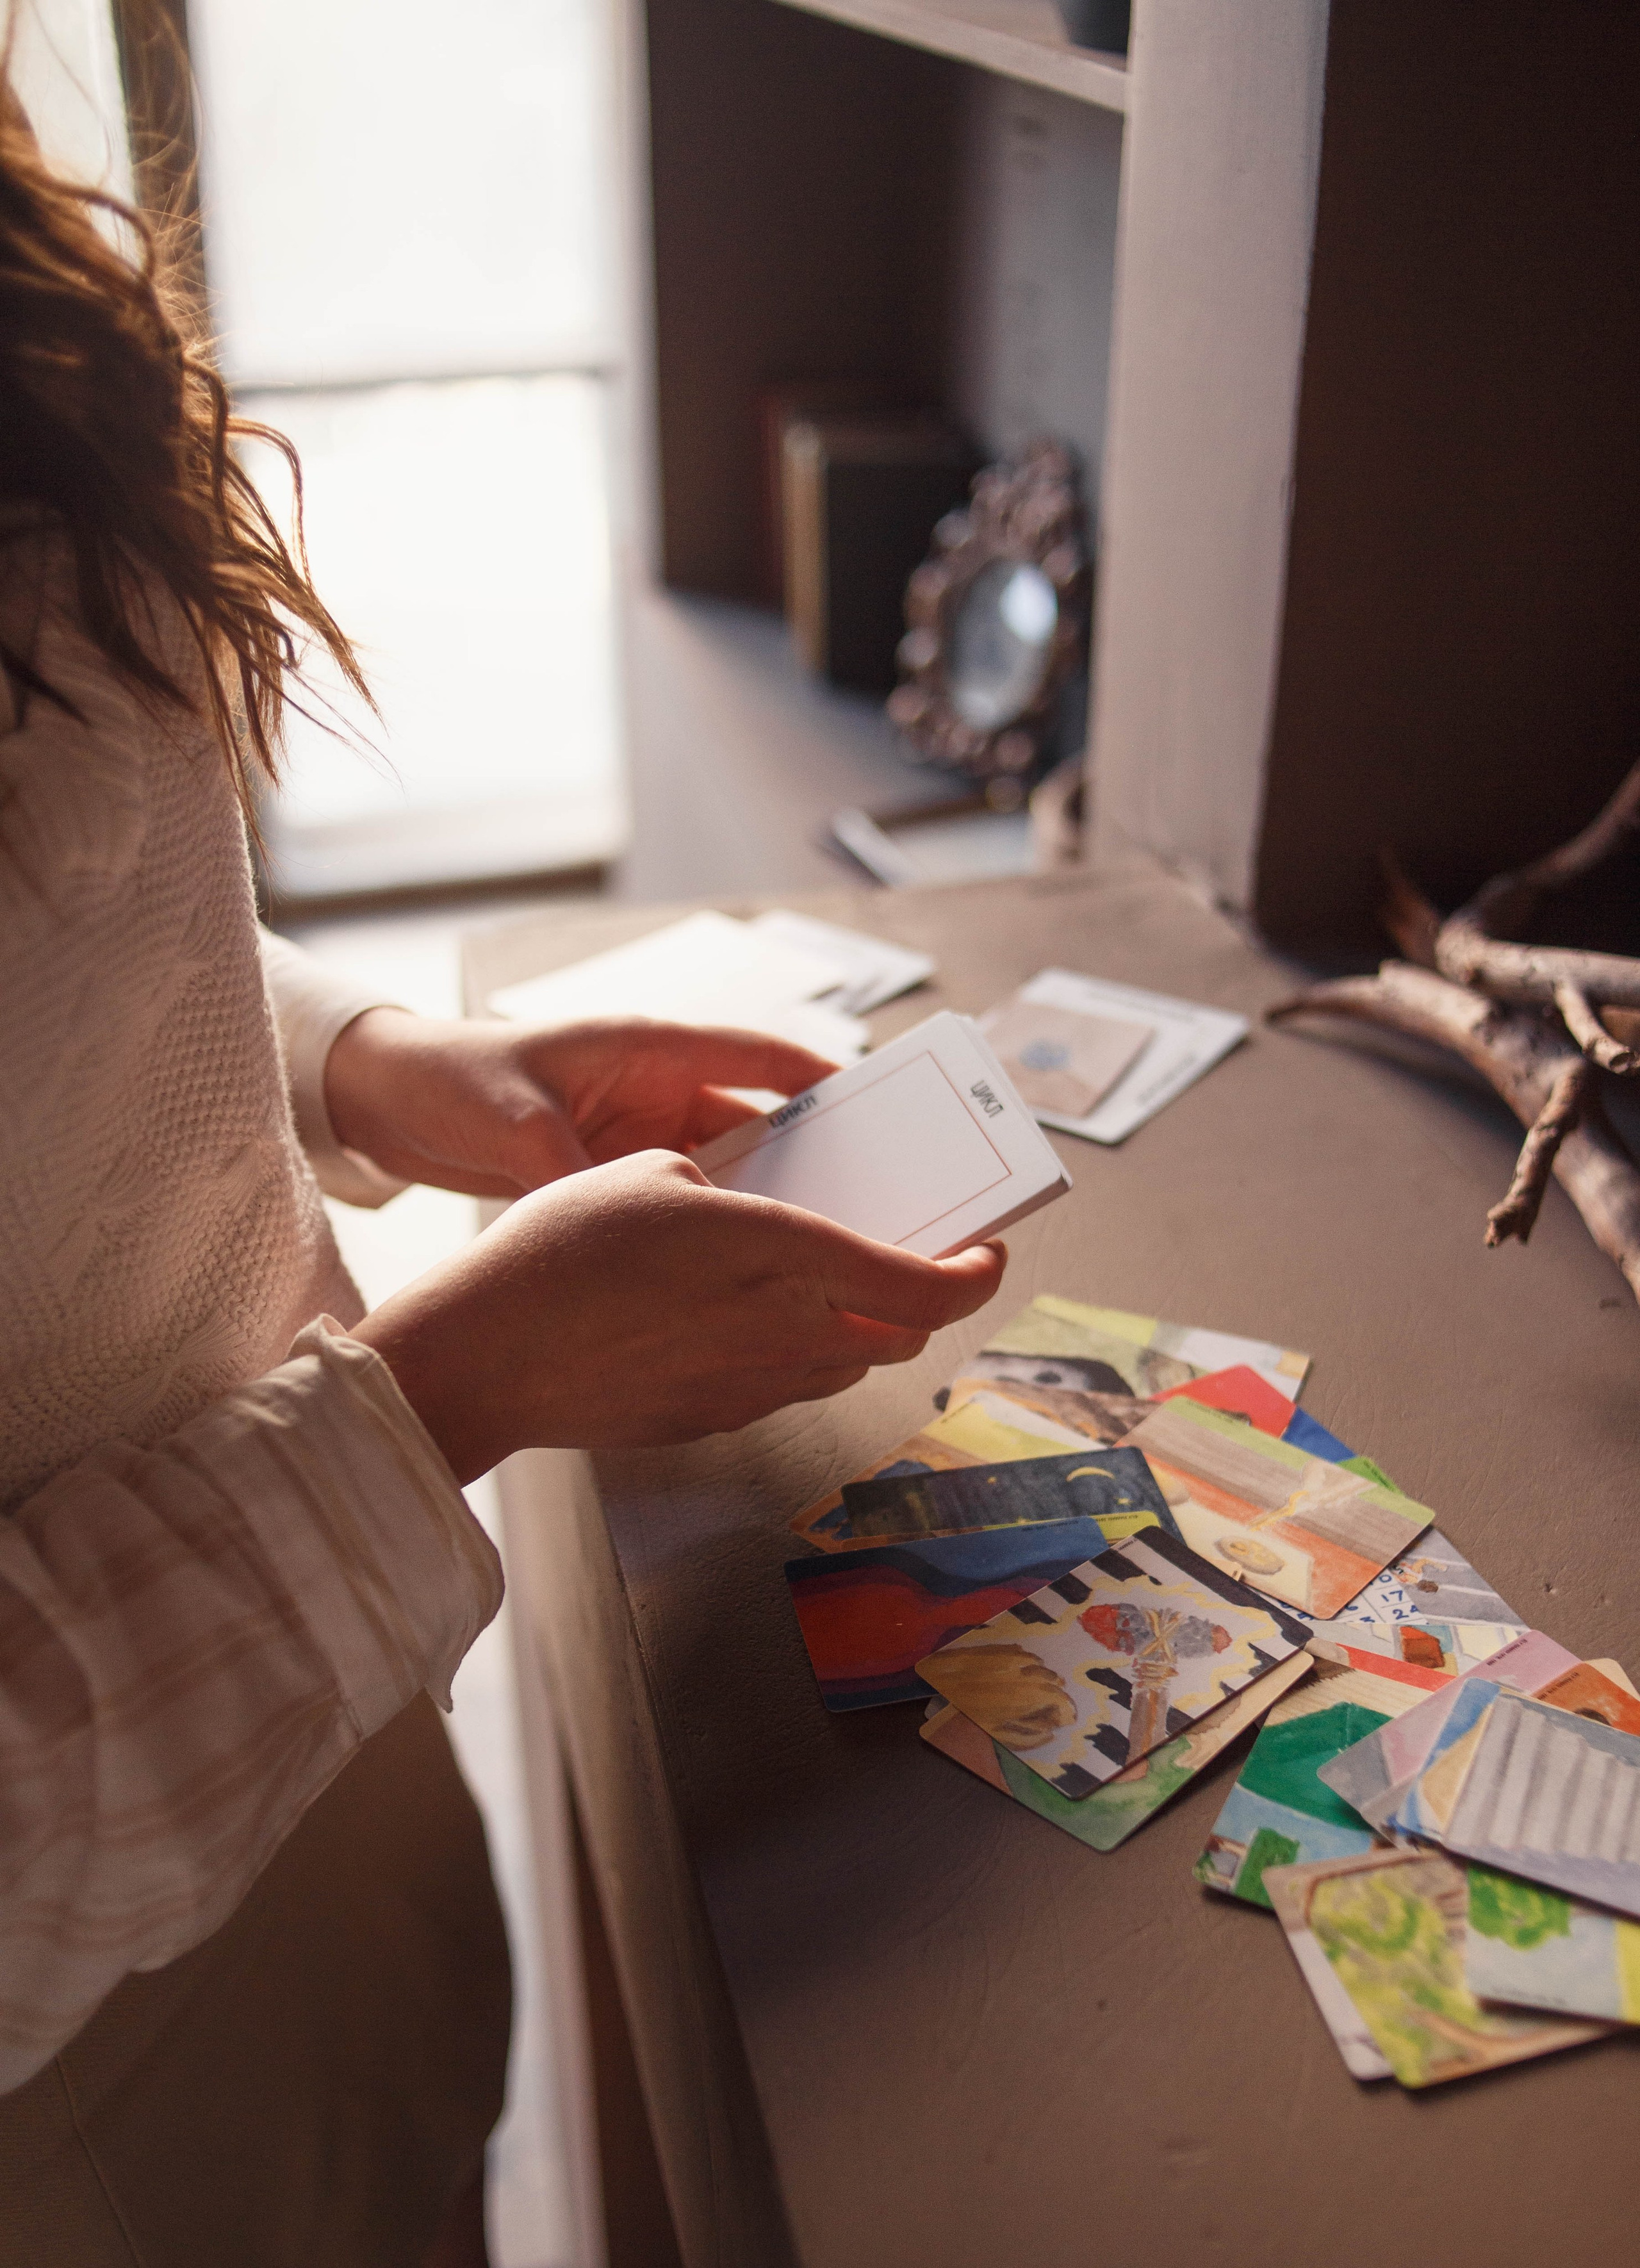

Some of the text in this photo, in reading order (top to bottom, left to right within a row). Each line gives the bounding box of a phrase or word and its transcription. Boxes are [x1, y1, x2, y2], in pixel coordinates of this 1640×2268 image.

[769, 1095, 817, 1128] ЦИКЛ
[969, 1080, 1005, 1119] ЦИКЛ
[1381, 1590, 1403, 1602] 17
